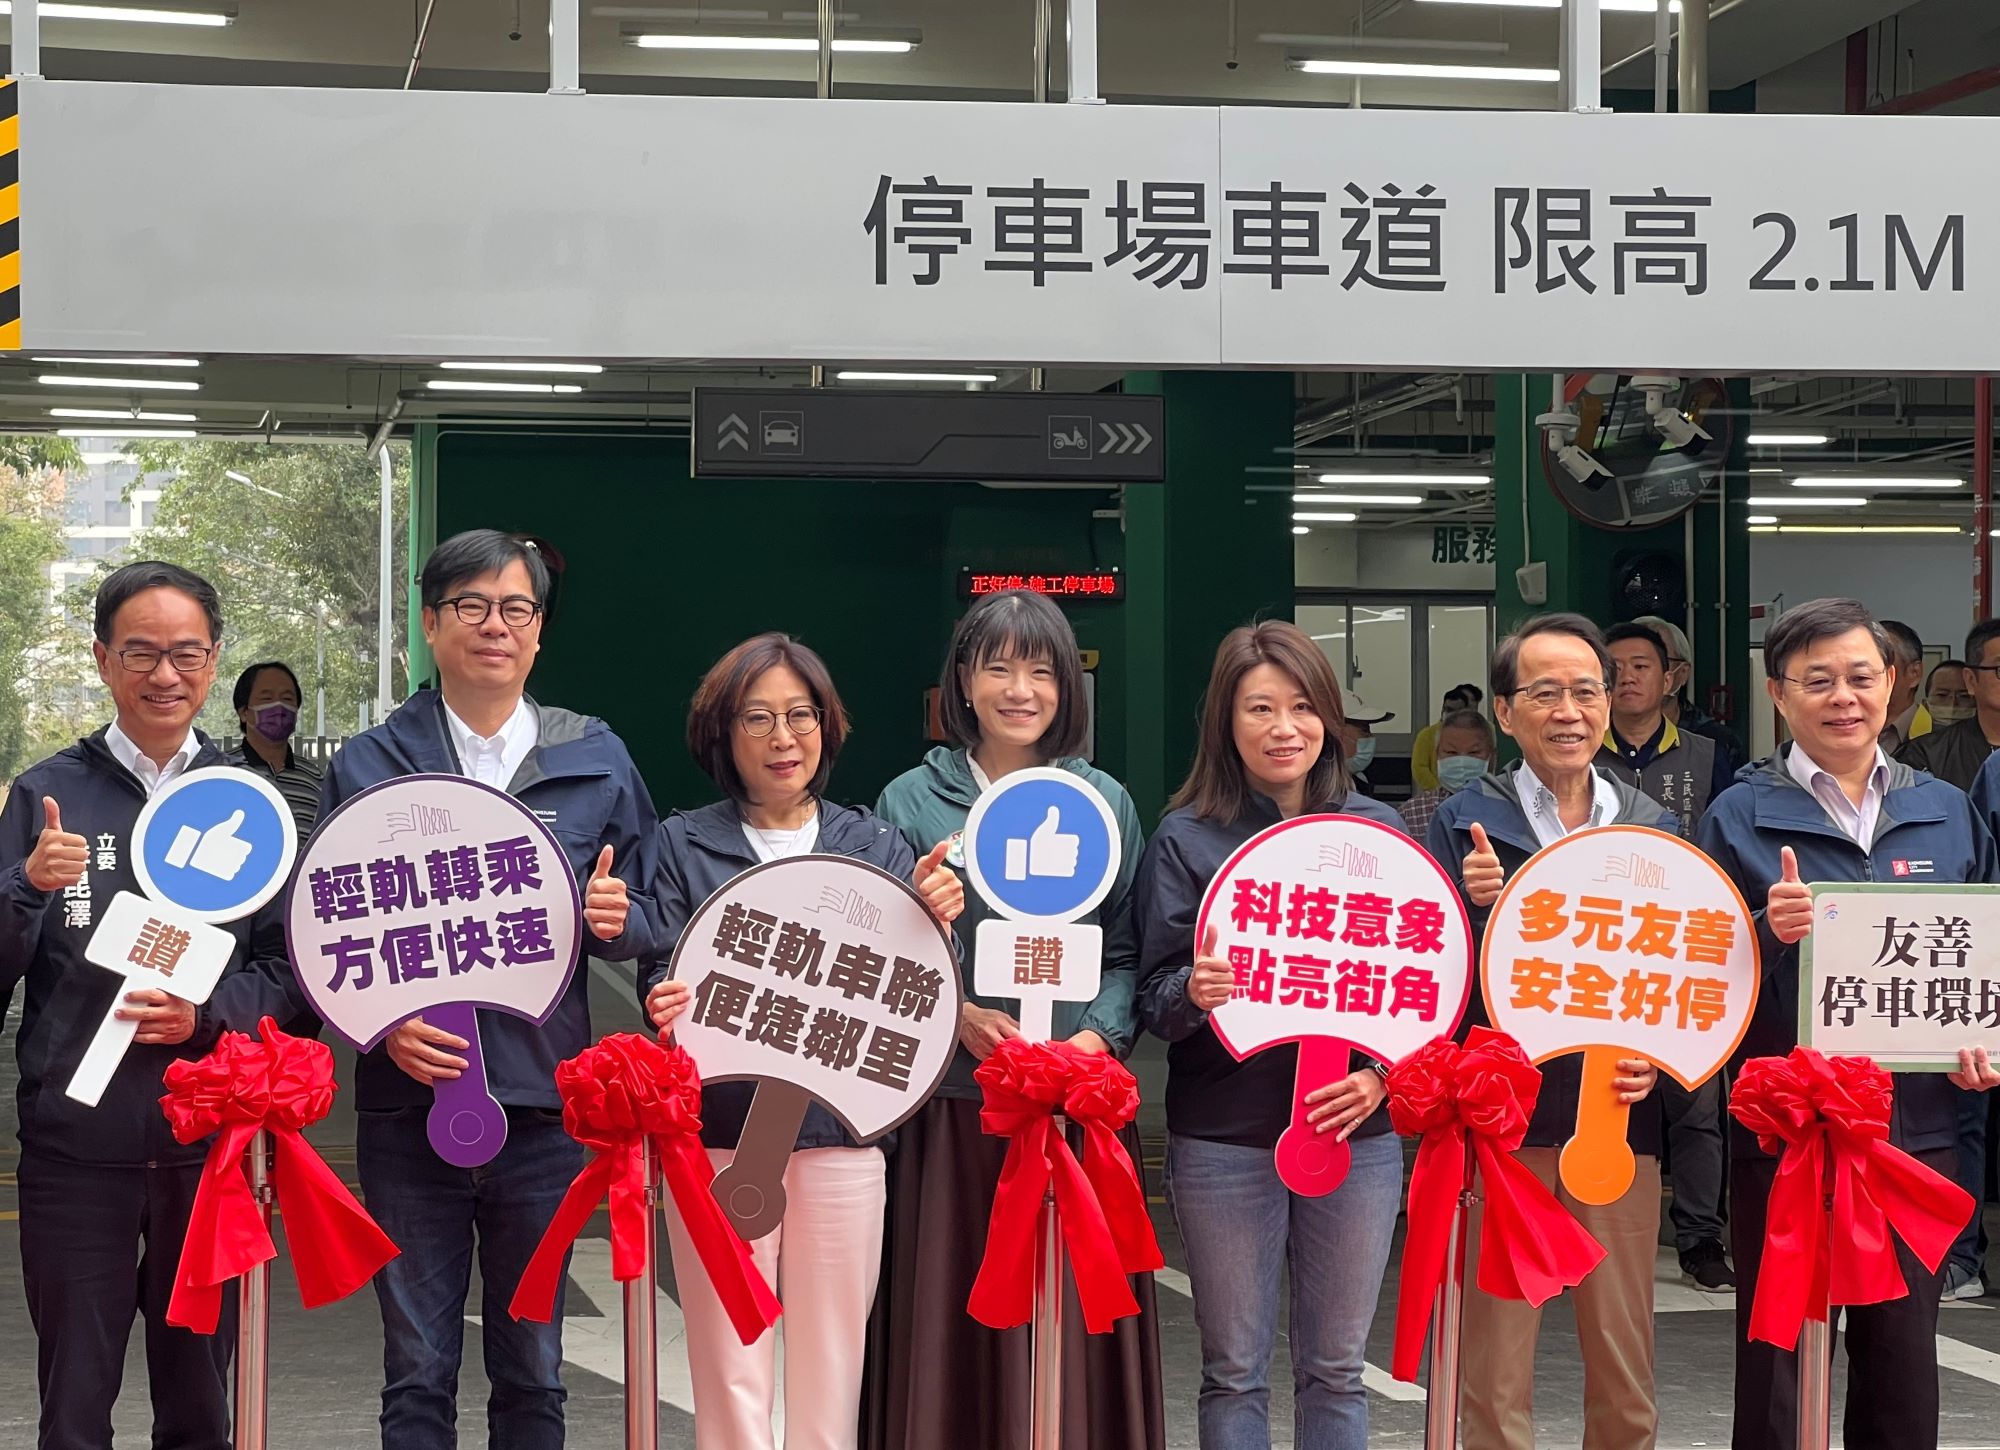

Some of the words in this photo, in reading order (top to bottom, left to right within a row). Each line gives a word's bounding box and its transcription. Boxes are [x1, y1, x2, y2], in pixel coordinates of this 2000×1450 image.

[863, 175, 1446, 291] 停車場車道
[1495, 187, 1711, 295] 限高
[1750, 213, 1963, 291] 2.1M
[96, 832, 117, 871] 立委
[309, 835, 543, 924] 輕軌轉乘
[127, 917, 192, 978] 讚
[320, 906, 555, 994] 方便快速
[1231, 878, 1445, 955] 科技意象
[1518, 888, 1735, 966] 多元友善
[1871, 915, 1973, 968] 友善
[712, 901, 945, 1023] 輕軌串聯
[1013, 935, 1063, 986] 讚
[1227, 945, 1440, 1022] 點亮街角
[1509, 957, 1729, 1032] 安全好停
